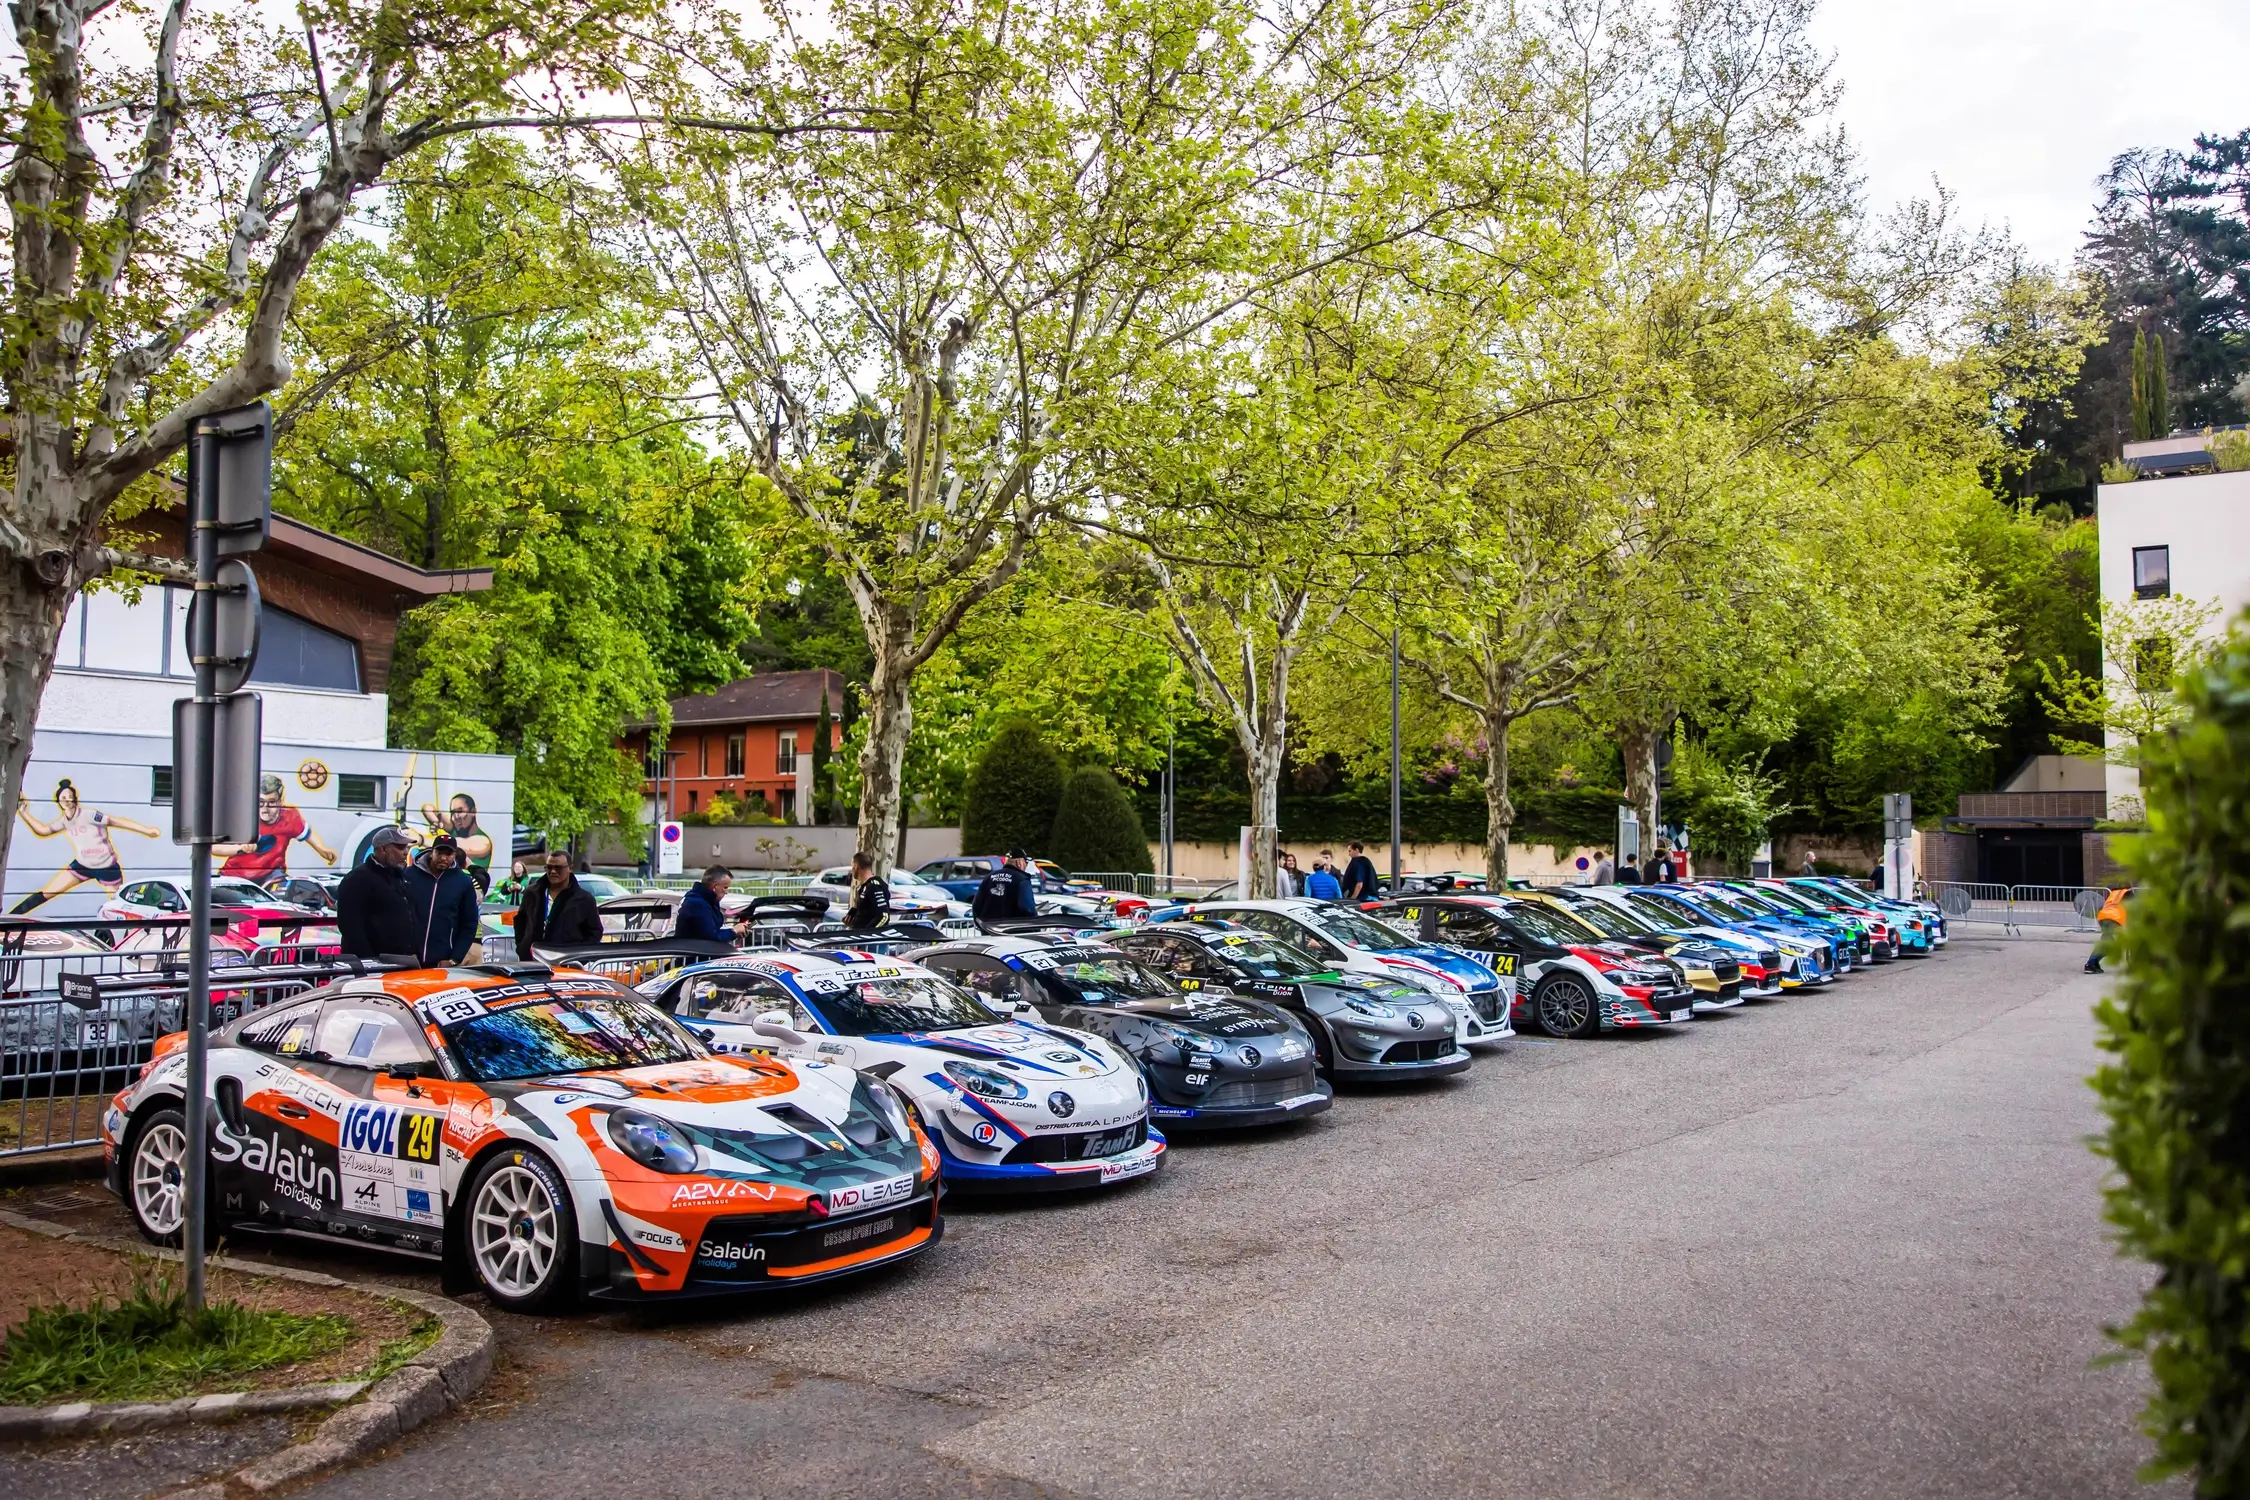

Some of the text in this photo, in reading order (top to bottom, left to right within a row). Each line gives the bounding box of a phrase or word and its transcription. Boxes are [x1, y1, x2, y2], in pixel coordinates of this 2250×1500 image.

[1405, 908, 1419, 919] 24
[1033, 957, 1054, 969] 27
[1496, 956, 1514, 975] 24
[71, 983, 92, 993] Brionne
[474, 980, 618, 1000] COSSON
[815, 979, 841, 991] 28
[1252, 984, 1294, 992] ALPINE
[441, 1001, 477, 1021] 29
[1185, 1073, 1210, 1086] elf
[255, 1064, 342, 1116] SHIFTECH
[979, 1097, 1037, 1109] TEAMFJ.COM
[341, 1102, 435, 1160] IGOL 29
[1035, 1121, 1092, 1131] DISTRIBUTEUR
[210, 1120, 337, 1201] Salaün
[528, 1161, 561, 1206] MICHELIN
[671, 1182, 727, 1201] A2V
[832, 1177, 913, 1208] MD LEASE
[354, 1199, 381, 1209] ALPINE
[671, 1199, 729, 1208] MECATRONIQUE
[640, 1230, 693, 1247] FOCUS ON
[698, 1239, 766, 1261] Salaün
[697, 1257, 738, 1270] Holidays
